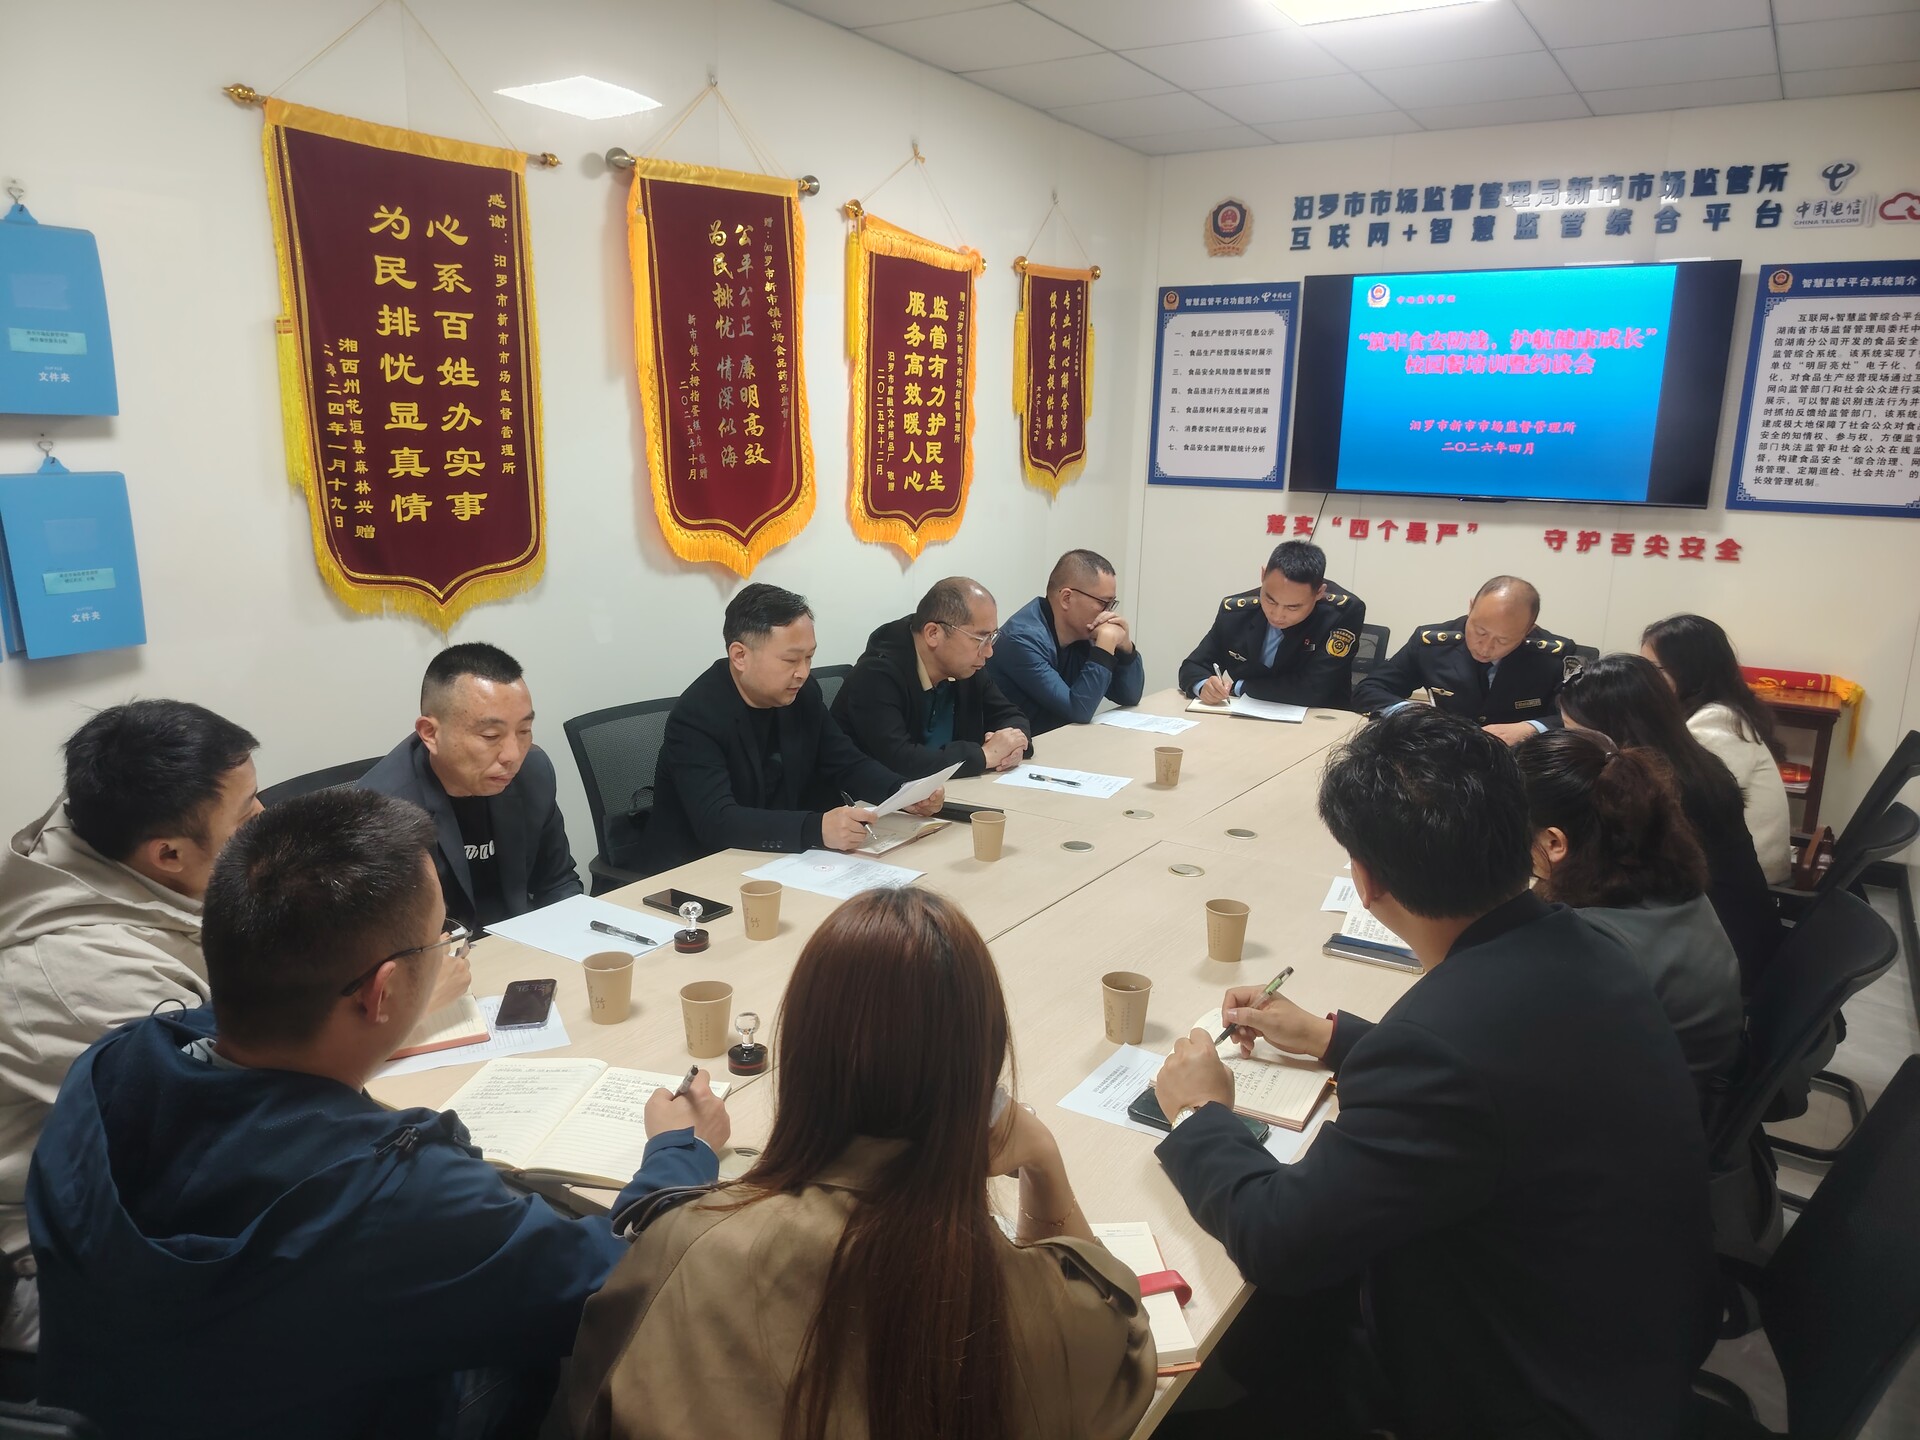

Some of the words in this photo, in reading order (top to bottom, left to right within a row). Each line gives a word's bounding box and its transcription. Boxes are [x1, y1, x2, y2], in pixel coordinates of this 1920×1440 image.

[1293, 163, 1789, 221] 汨罗市市场监督管理局新市市场监管所
[1796, 199, 1862, 219] 中国电信
[1290, 199, 1783, 251] 互联网+智慧监管综合平台
[708, 219, 735, 339] 为民排忧
[734, 224, 754, 337] 公平公正
[1801, 275, 1918, 289] 智慧监管平台系统简介
[38, 371, 70, 383] 文件夹
[369, 205, 432, 523] 为民排忧显真情
[426, 213, 488, 522] 心系百姓办实事
[1405, 353, 1596, 375] 校园餐培训暨约谈会
[1772, 349, 1920, 359] 监管综合系统。该系统实现了
[717, 355, 738, 469] 情深似海
[902, 290, 927, 492] 服务高效暖人心
[925, 295, 950, 492] 监管有力护民生
[1409, 419, 1577, 435] 汨罗市新市市场监督管理所
[1543, 528, 1743, 562] 守护舌尖安全
[71, 611, 101, 623] 文件夹
